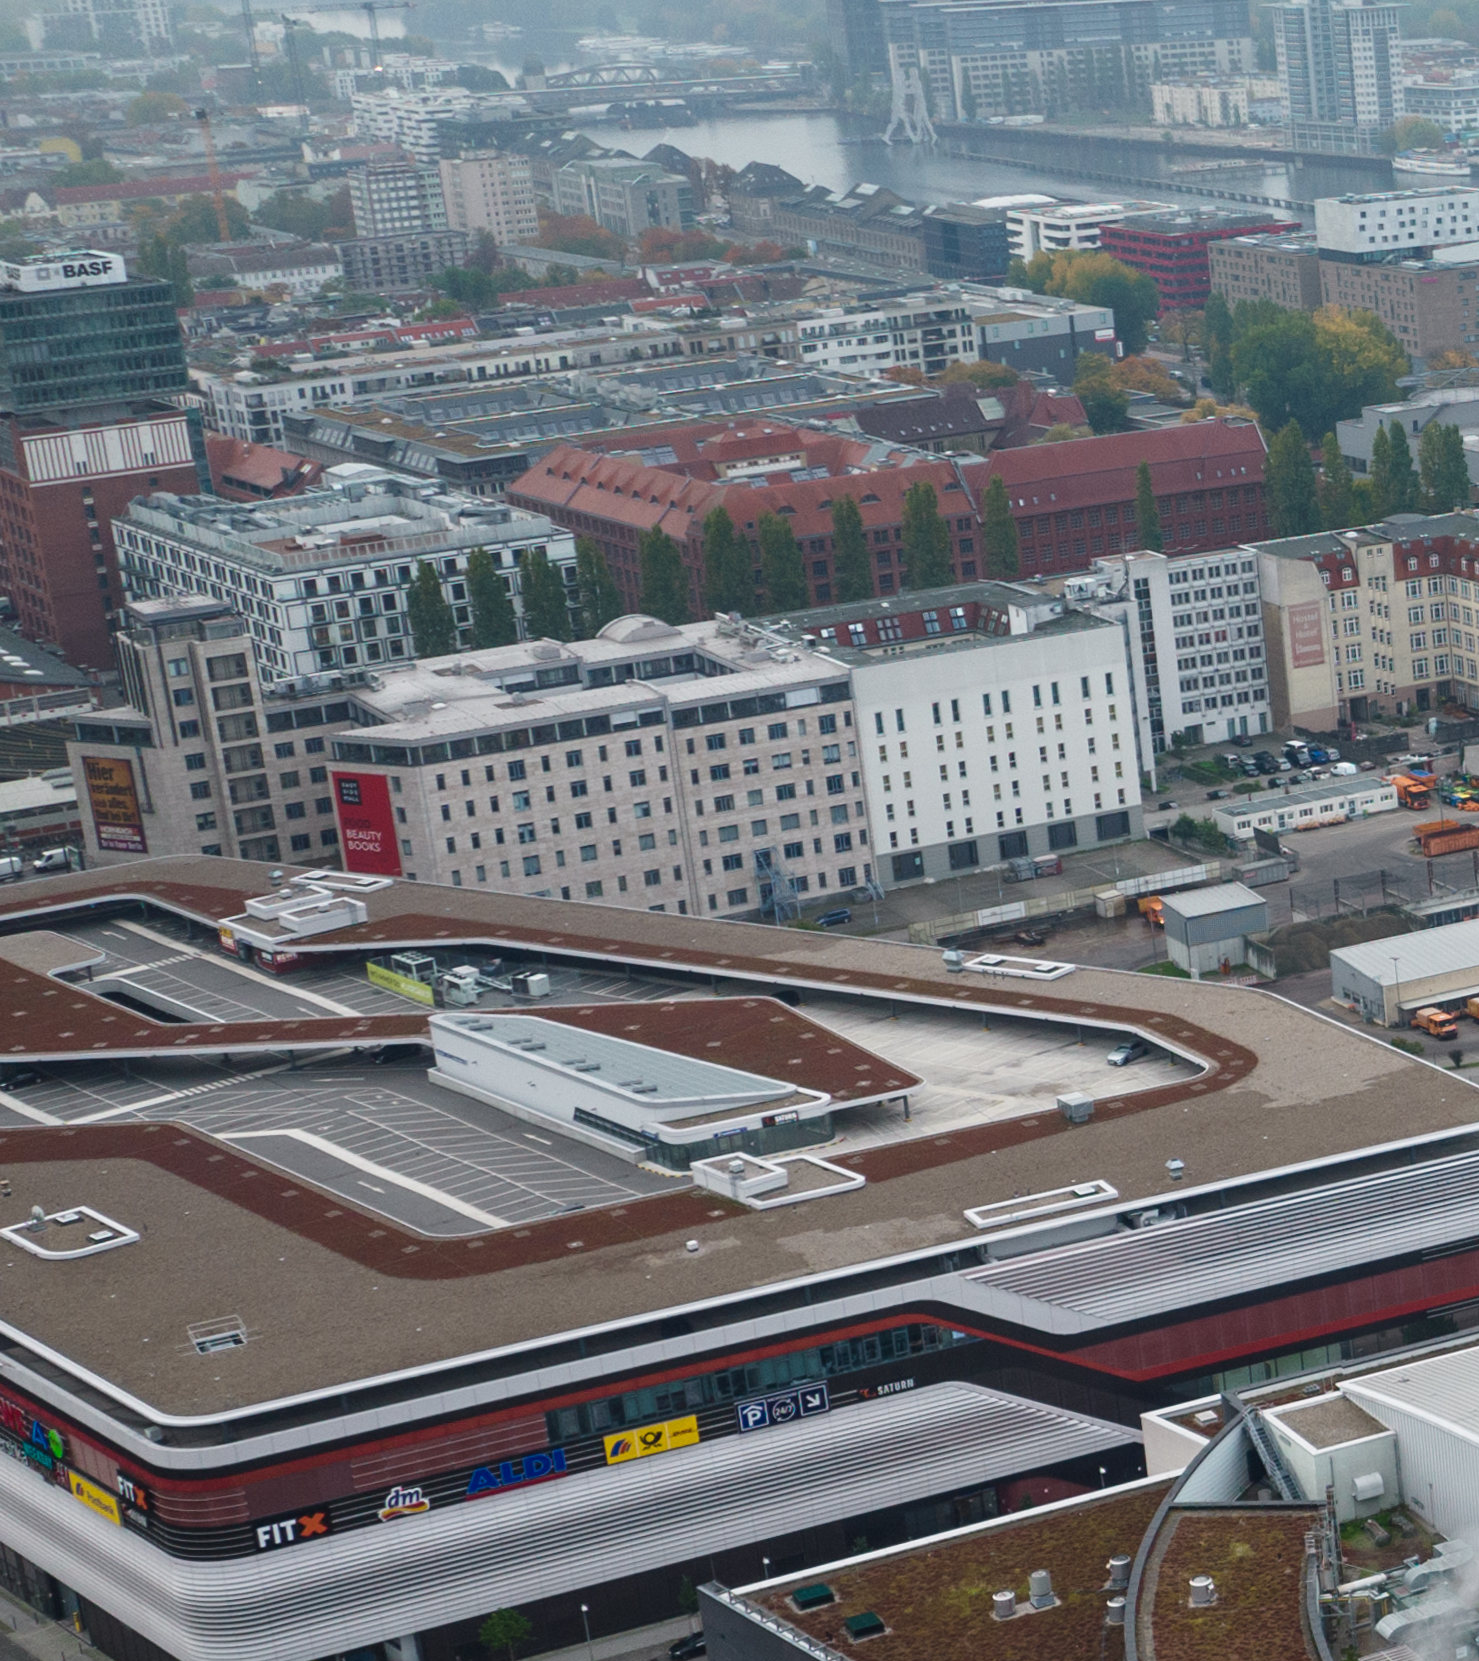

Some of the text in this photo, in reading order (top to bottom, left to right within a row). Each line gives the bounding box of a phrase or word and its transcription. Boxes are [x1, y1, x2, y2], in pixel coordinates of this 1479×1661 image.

[62, 260, 112, 279] BASF
[86, 761, 114, 781] Hier
[346, 829, 381, 841] BEAUTY
[348, 841, 380, 852] BOOKS
[877, 1379, 914, 1395] SATURN
[774, 1404, 794, 1416] 24/7
[466, 1448, 566, 1494] ALDI
[386, 1487, 422, 1509] dm
